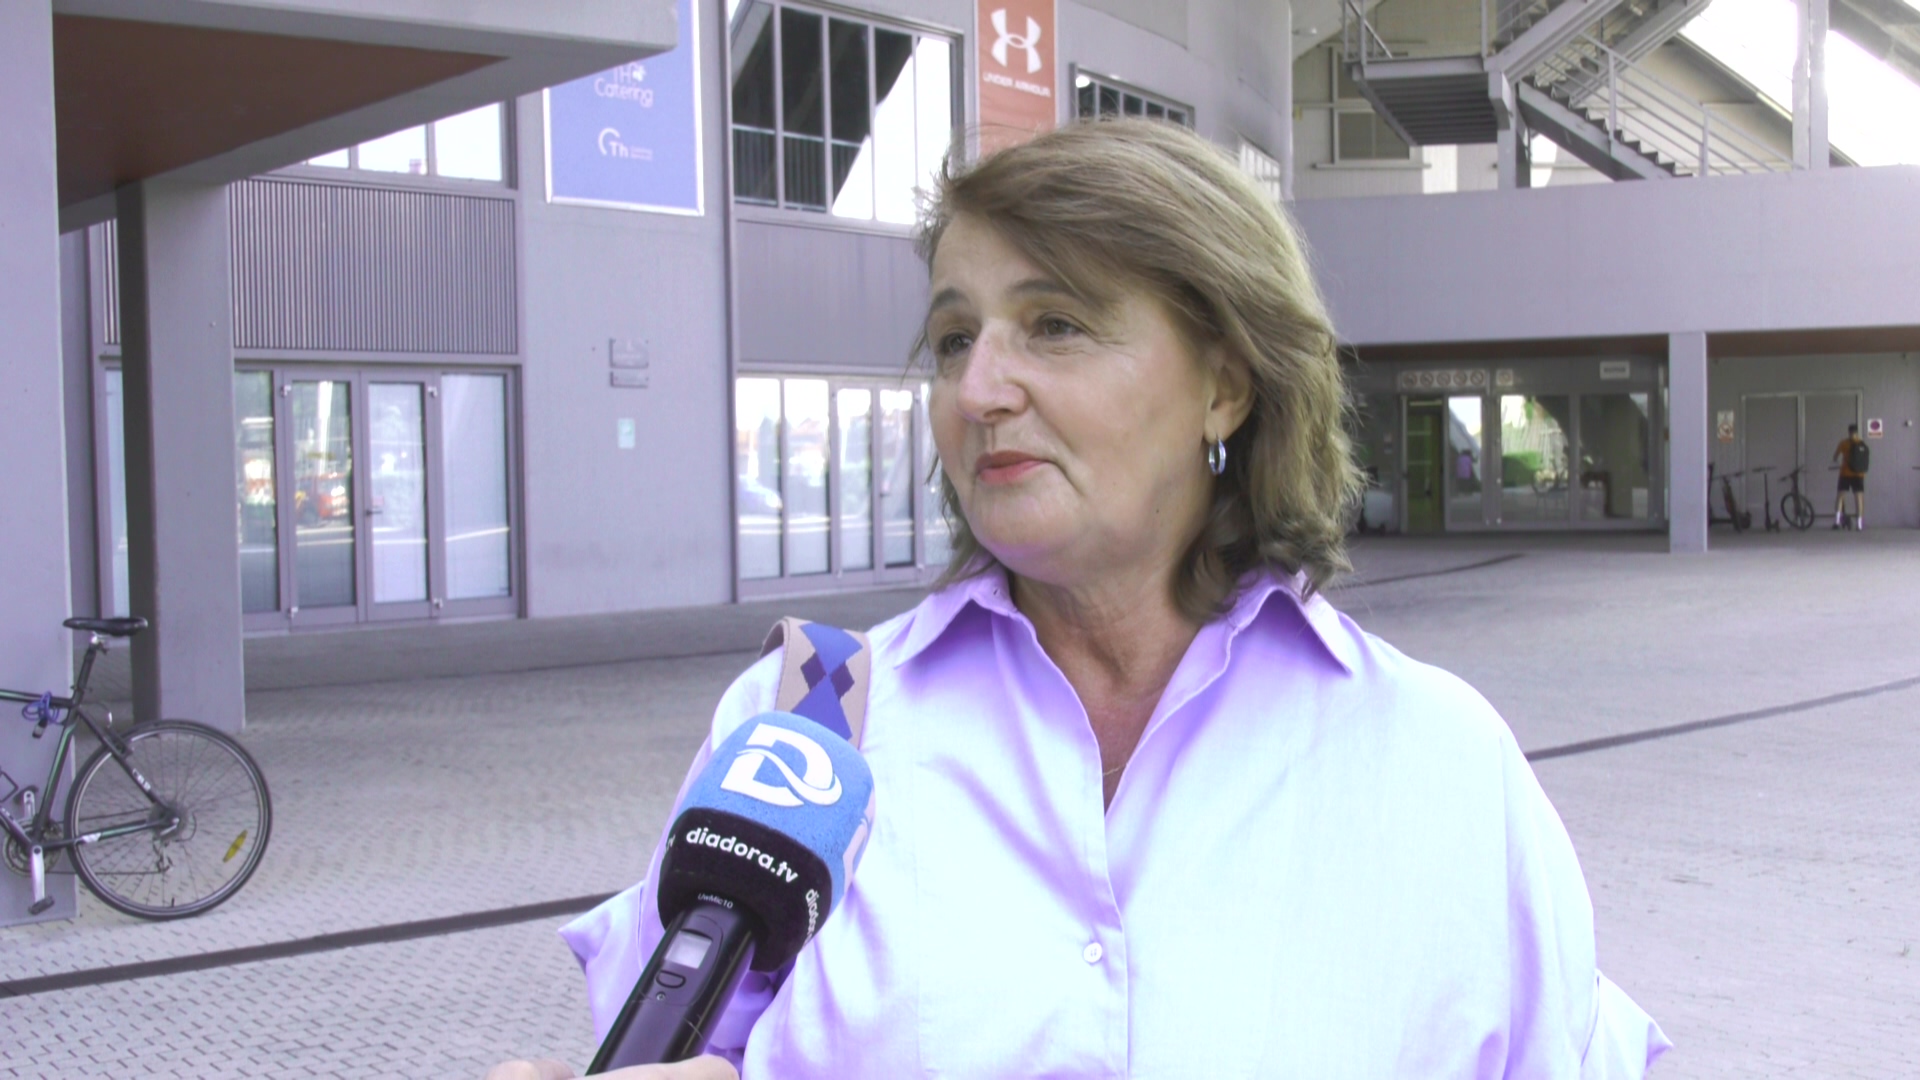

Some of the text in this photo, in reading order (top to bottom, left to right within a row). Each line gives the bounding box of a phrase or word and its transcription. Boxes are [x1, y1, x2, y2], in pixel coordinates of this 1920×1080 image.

[594, 78, 653, 107] Catering
[686, 828, 798, 883] diadora.tv
[697, 893, 733, 909] UwMic10
